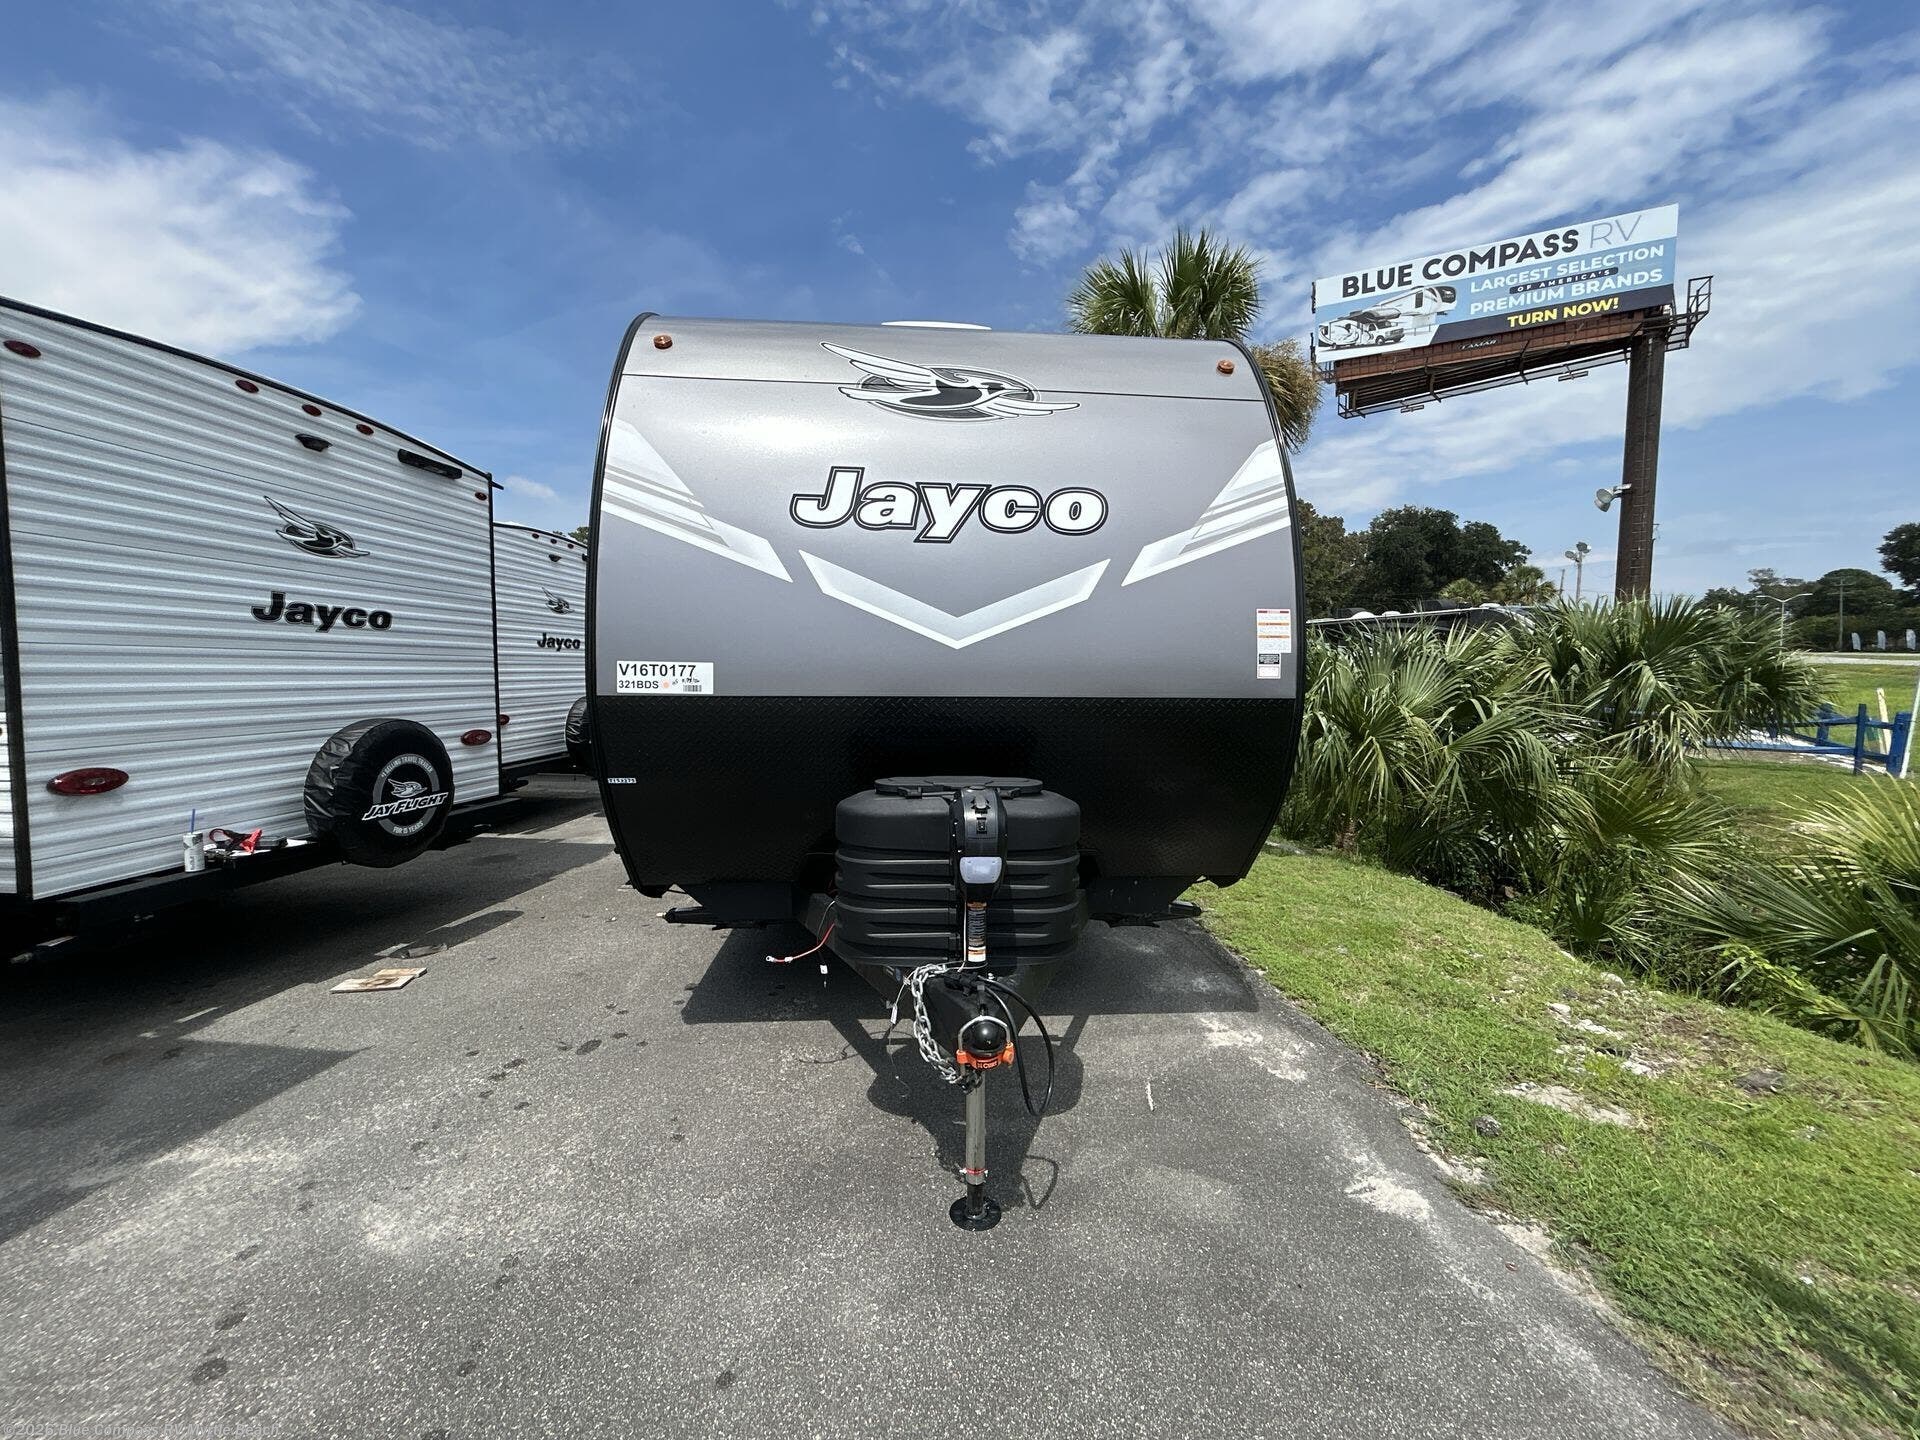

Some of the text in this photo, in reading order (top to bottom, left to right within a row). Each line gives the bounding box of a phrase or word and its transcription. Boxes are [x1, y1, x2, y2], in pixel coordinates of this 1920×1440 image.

[1342, 215, 1642, 298] BLUE COMPASS RV
[1470, 244, 1665, 293] LARGEST SELECTION
[1470, 268, 1663, 315] PREMIUM BRANDS
[1517, 269, 1611, 292] OF AMERICA'S
[1507, 297, 1619, 328] TURN NOW!
[789, 466, 1109, 544] Jayco
[250, 590, 394, 633] Jayco
[536, 632, 581, 653] Jayco
[618, 663, 697, 677] V16T0177
[618, 680, 660, 689] 321BDS
